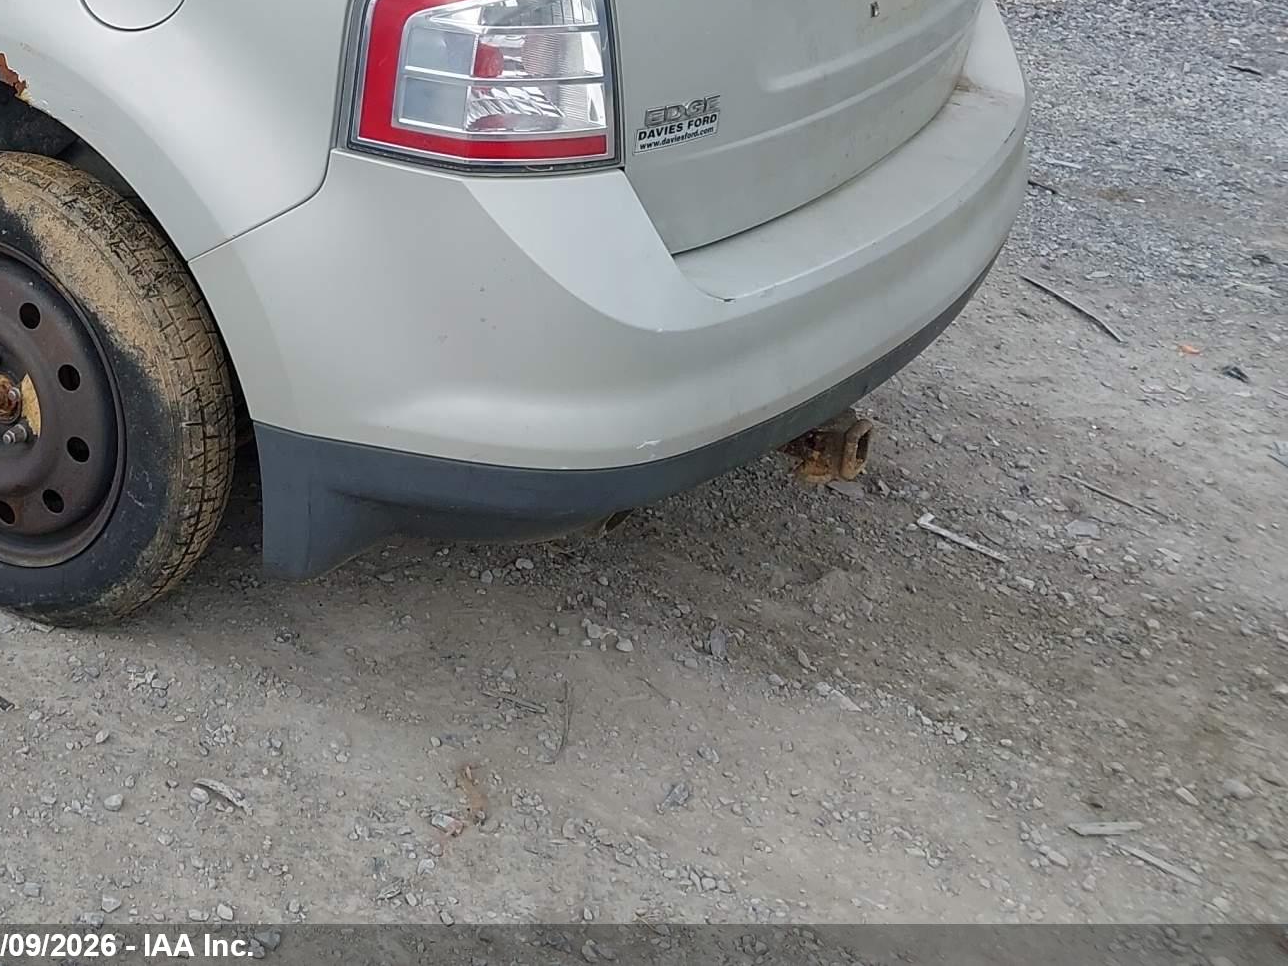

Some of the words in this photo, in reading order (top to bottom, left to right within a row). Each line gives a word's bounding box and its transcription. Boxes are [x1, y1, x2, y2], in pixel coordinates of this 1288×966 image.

[644, 94, 721, 128] EDGE
[638, 122, 684, 142] DAVIES
[687, 113, 718, 130] FORD
[639, 126, 714, 151] www.daviesford.com
